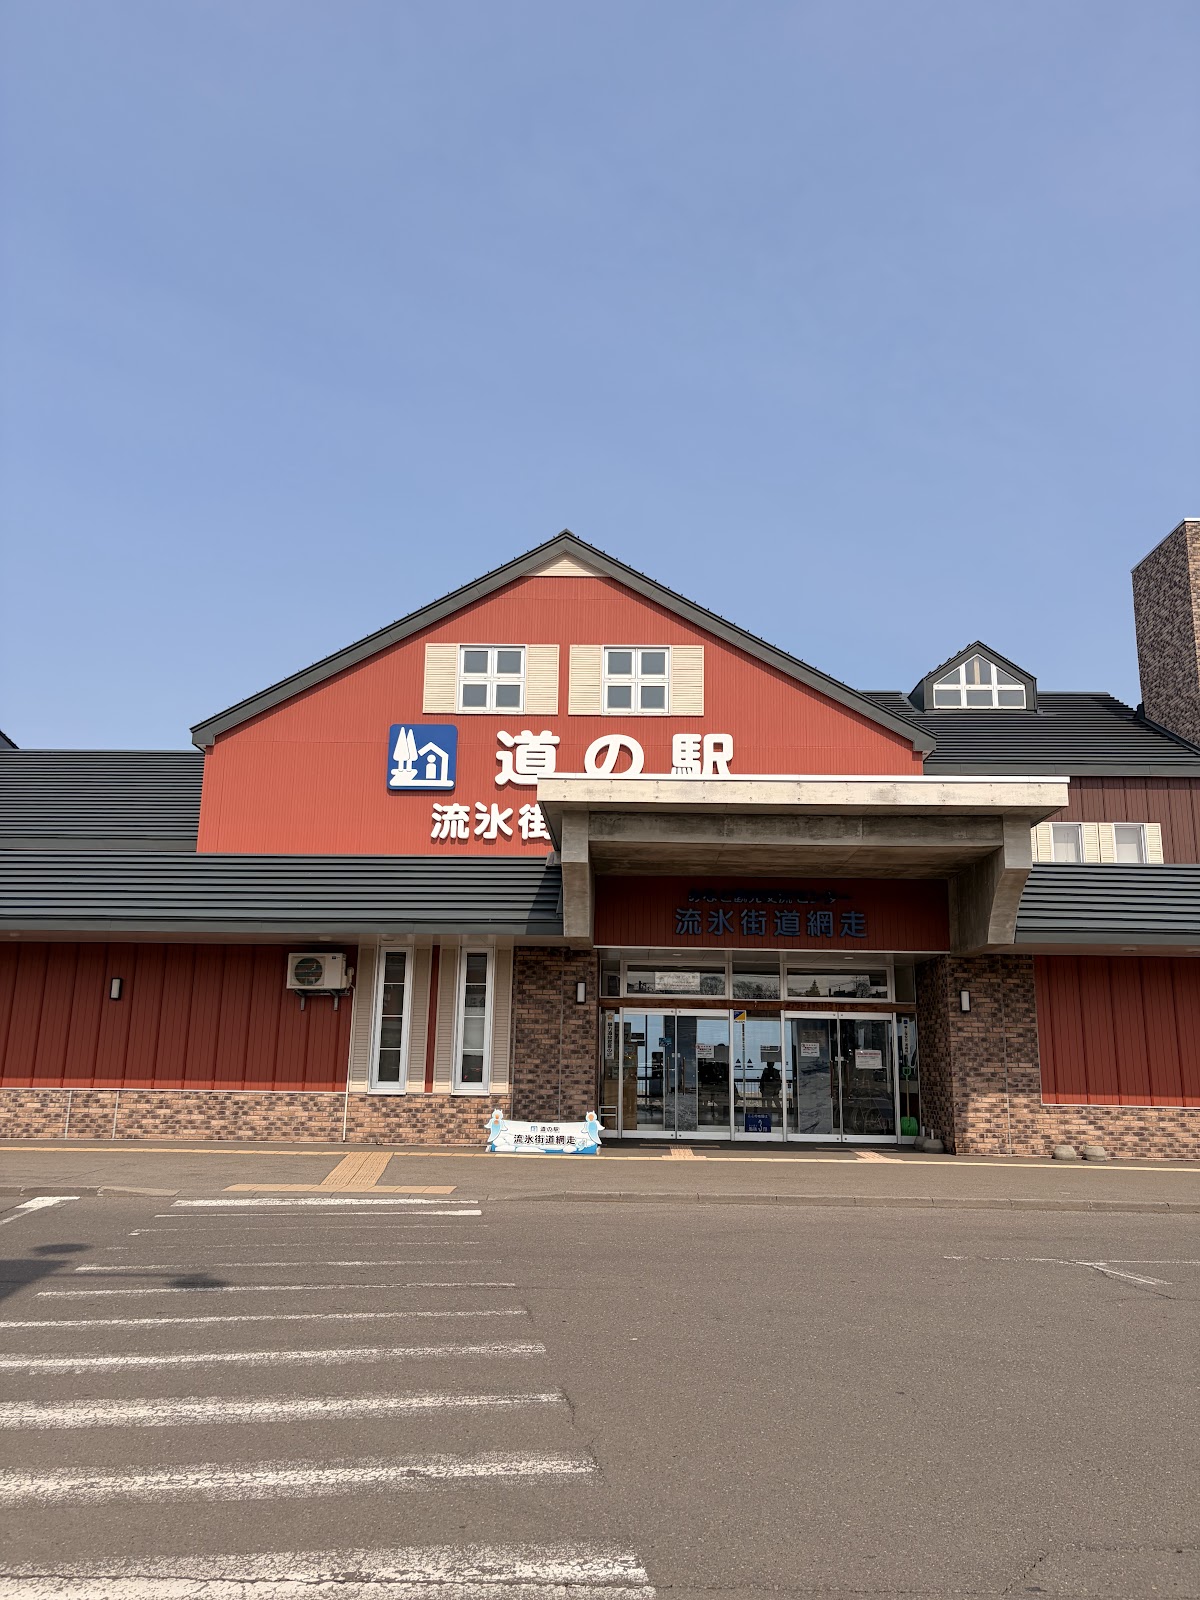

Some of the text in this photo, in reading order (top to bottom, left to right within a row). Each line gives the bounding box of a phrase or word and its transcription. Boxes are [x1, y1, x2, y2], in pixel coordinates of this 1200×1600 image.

[495, 730, 735, 786] 道の駅
[675, 908, 868, 938] 流氷街道網走
[513, 1134, 576, 1145] 流氷街道網走
